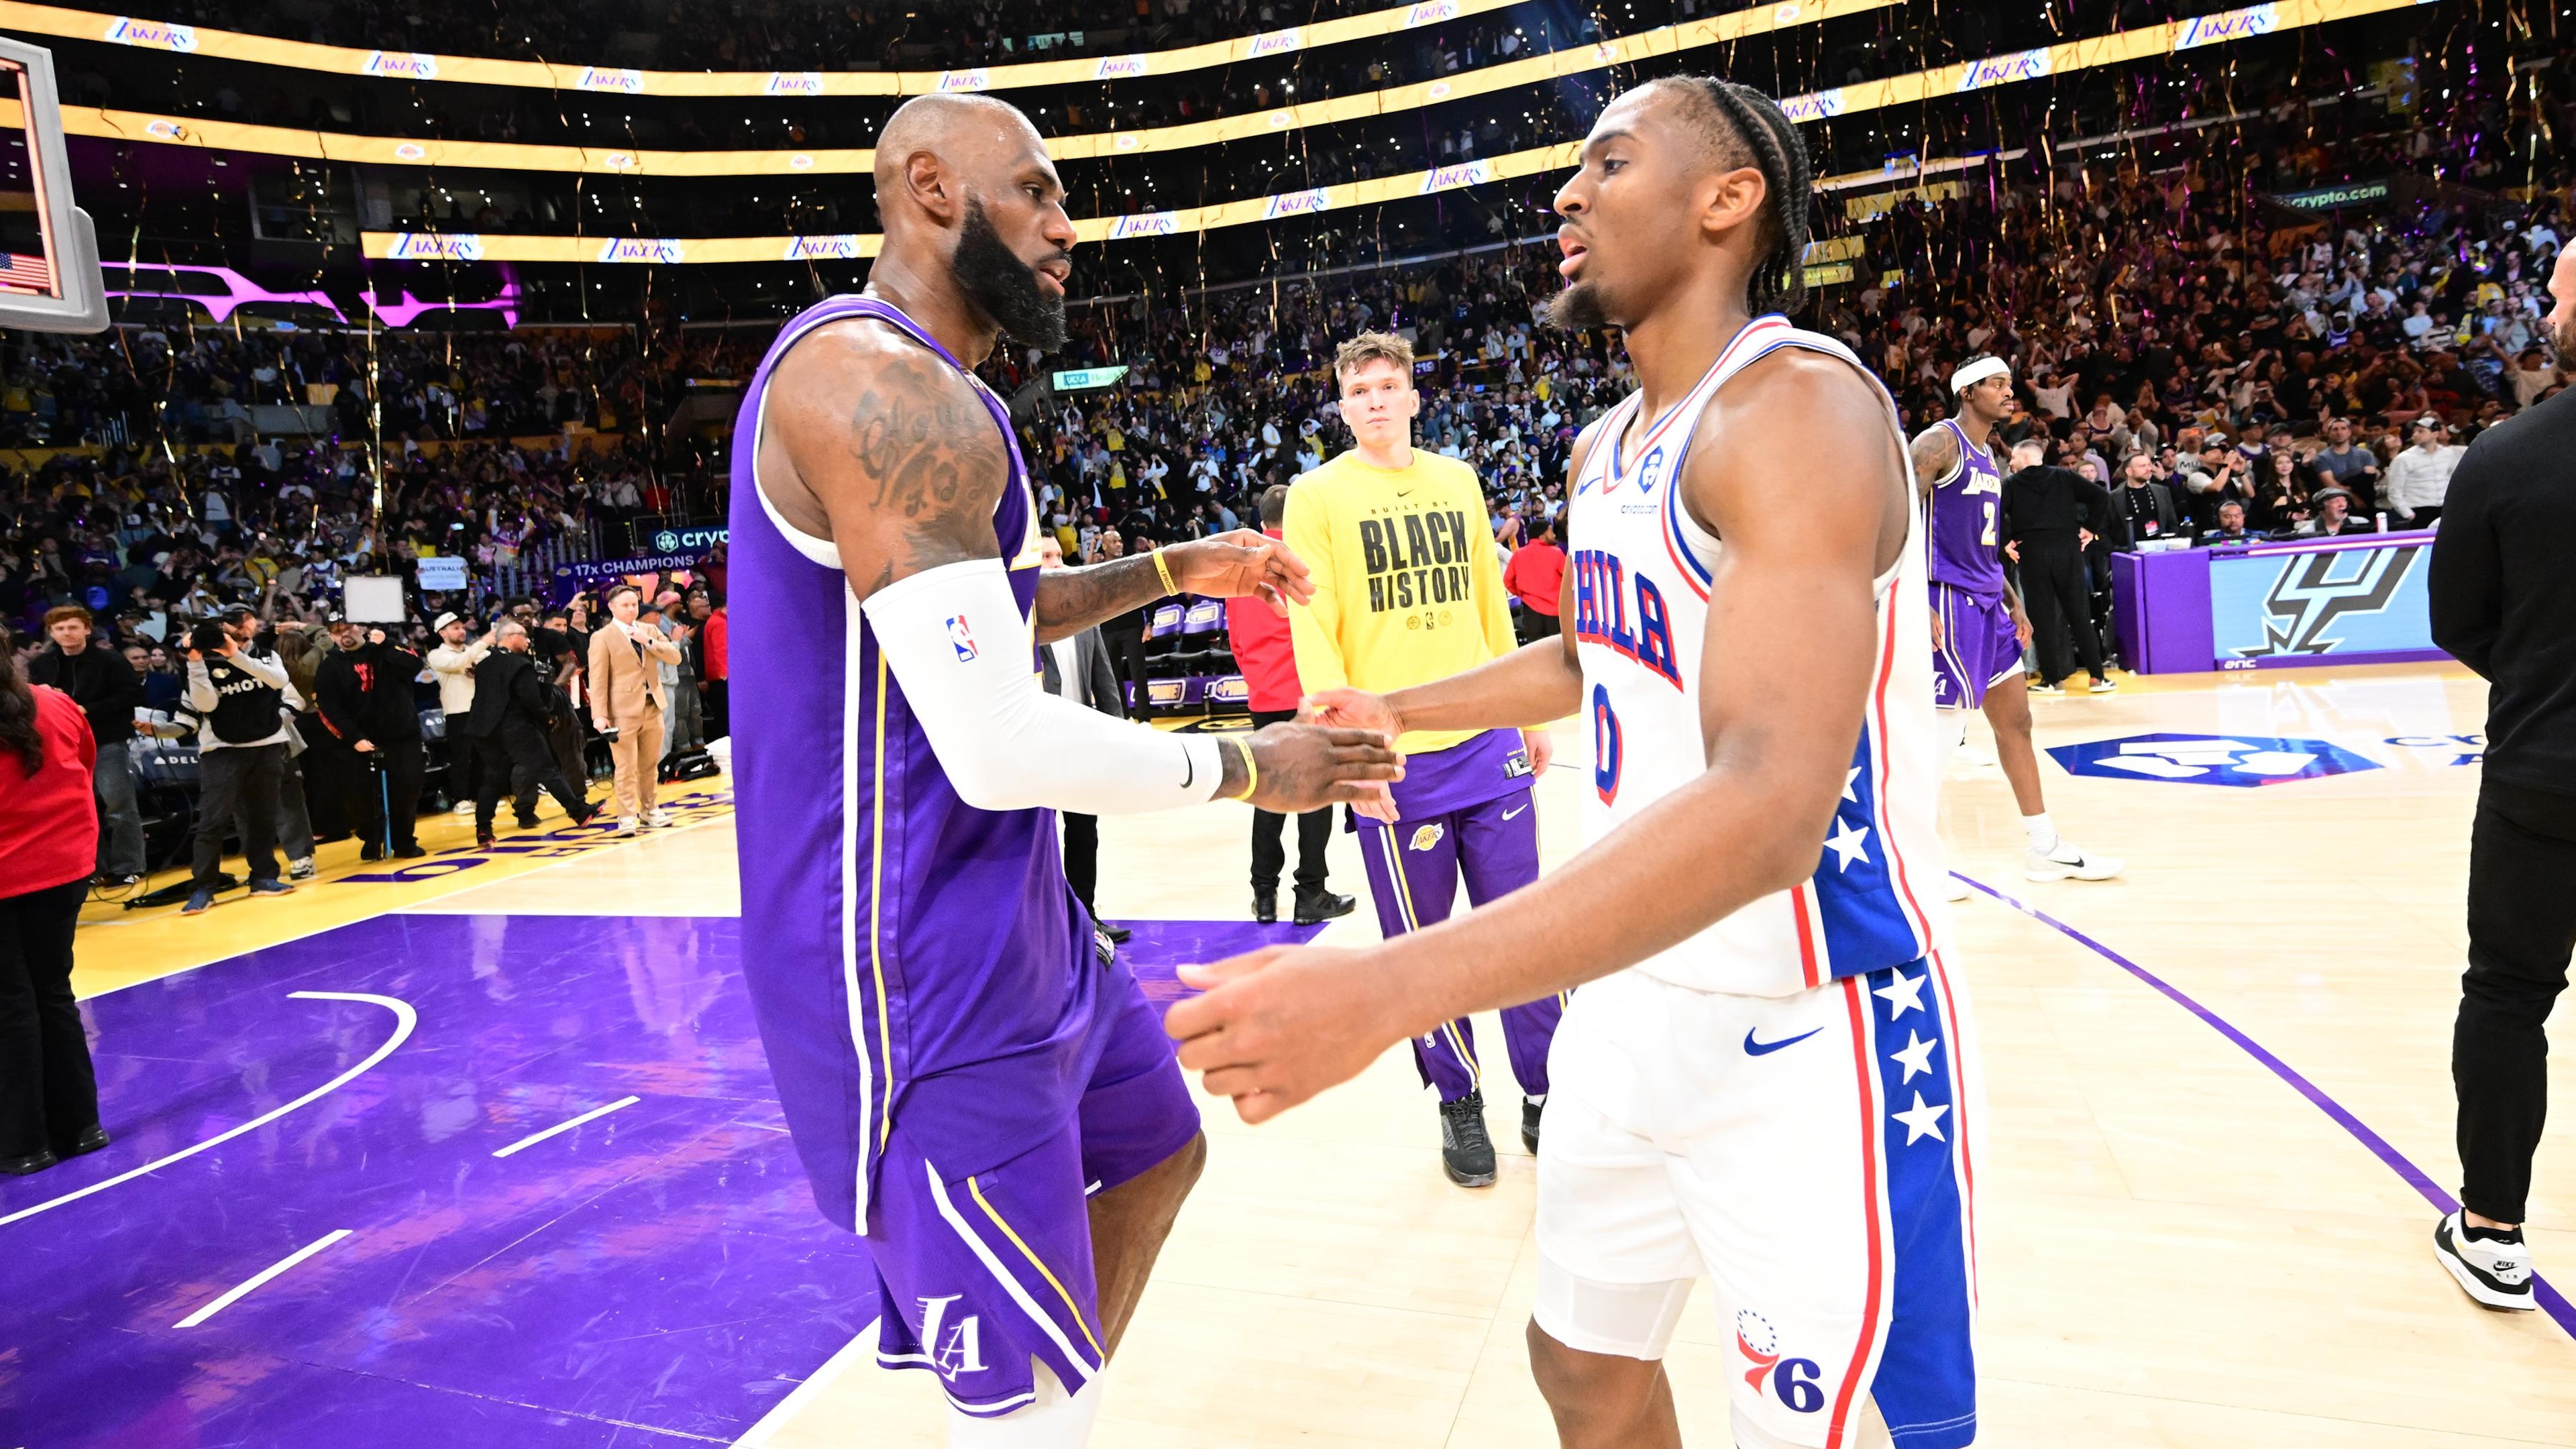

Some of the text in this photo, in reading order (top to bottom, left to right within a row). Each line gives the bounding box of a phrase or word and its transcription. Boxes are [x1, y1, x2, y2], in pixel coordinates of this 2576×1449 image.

[2292, 185, 2387, 209] crypto.com
[1371, 504, 1419, 515] BUILT
[1981, 501, 1996, 546] 2
[575, 555, 695, 576] 17x CHAMPIONS
[1359, 511, 1469, 575] BLACK
[1368, 566, 1469, 612] HISTORY
[1572, 549, 1684, 694] HILA
[2224, 659, 2257, 669] anc
[1593, 682, 1622, 808] 0
[2496, 1260, 2516, 1268] NIKE
[2496, 1272, 2518, 1280] AIR
[916, 1293, 989, 1383] LA
[1737, 1319, 1825, 1413] 76
